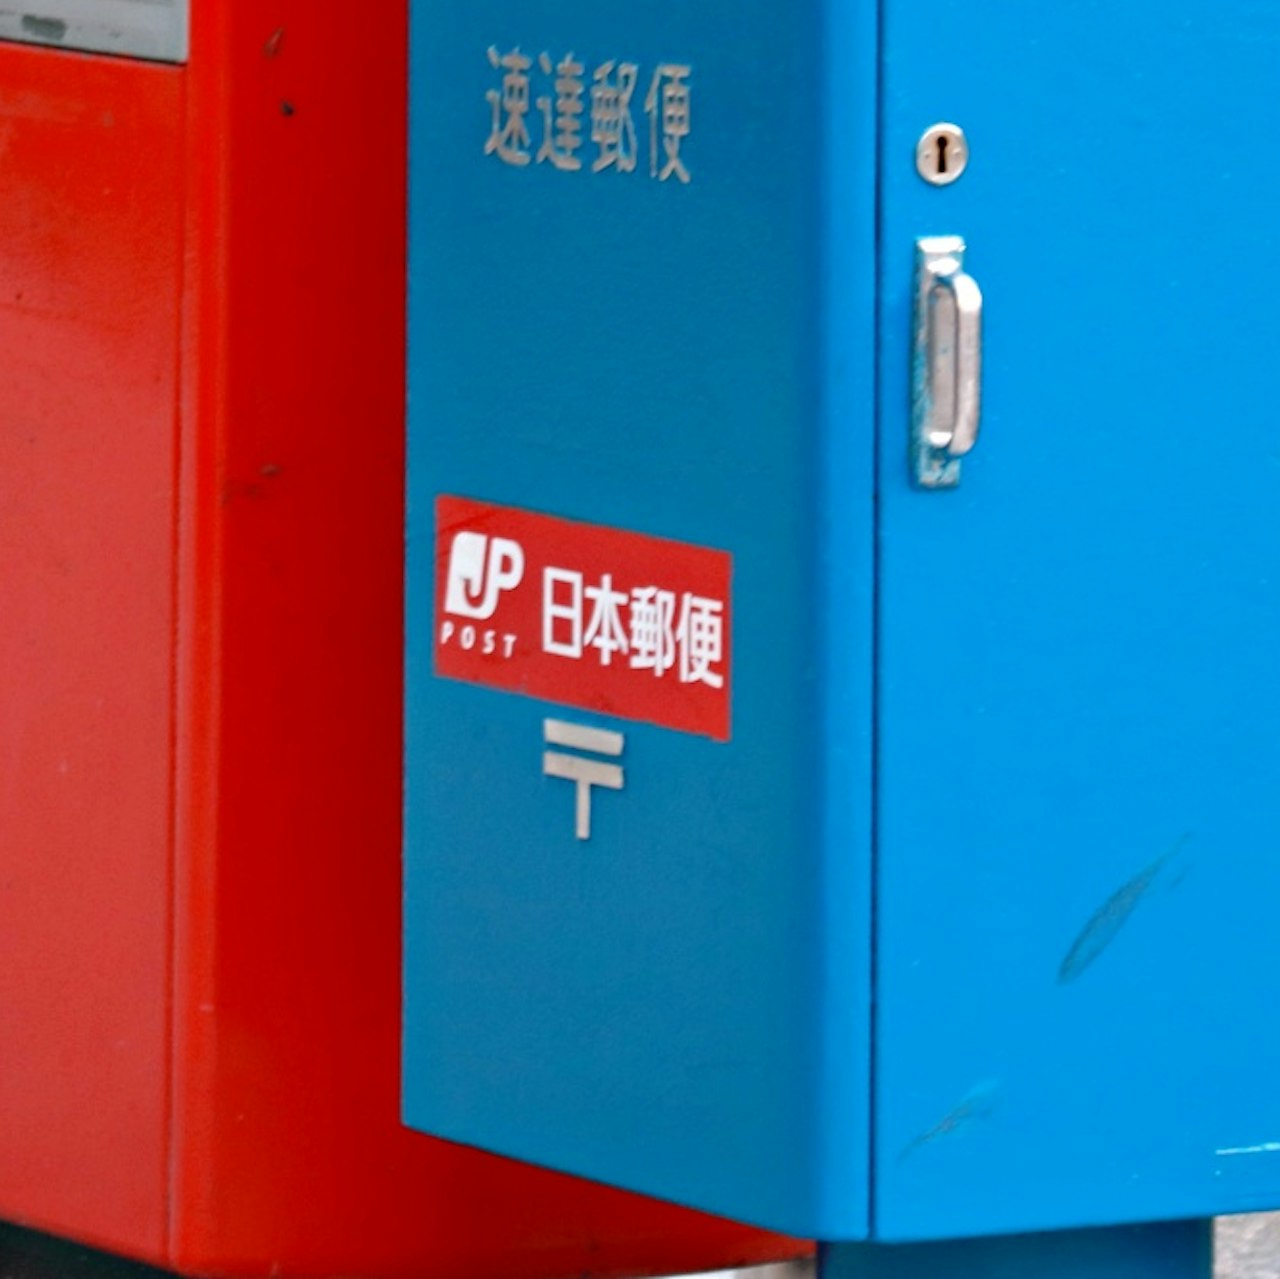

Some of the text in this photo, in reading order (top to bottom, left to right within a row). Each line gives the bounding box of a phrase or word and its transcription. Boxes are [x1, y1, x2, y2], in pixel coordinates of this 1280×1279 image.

[484, 45, 691, 184] 速達郵便
[441, 621, 517, 658] POST
[542, 566, 724, 689] 日本郵便
